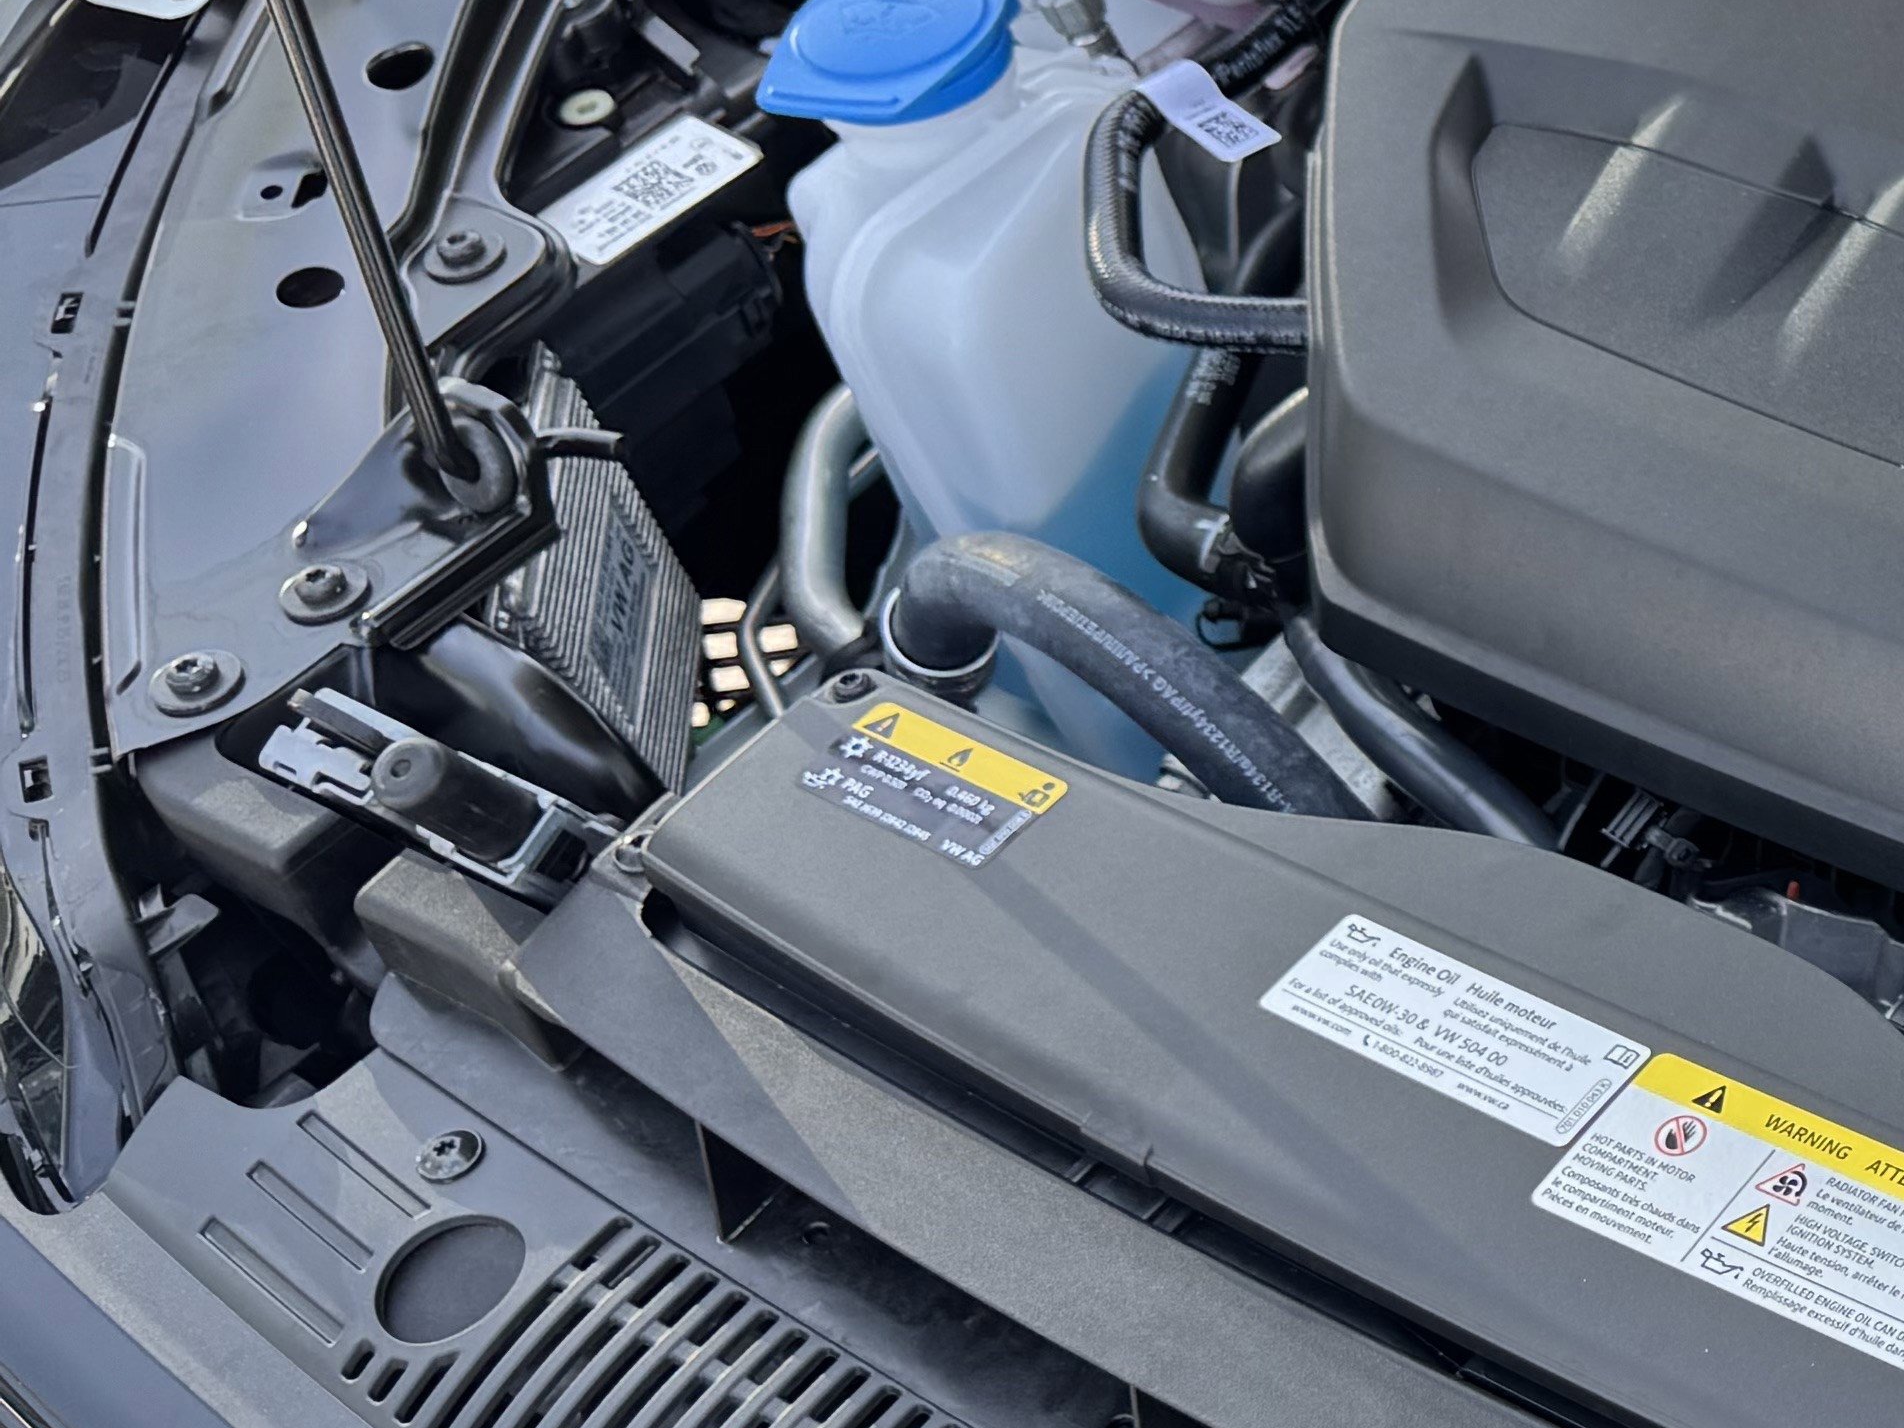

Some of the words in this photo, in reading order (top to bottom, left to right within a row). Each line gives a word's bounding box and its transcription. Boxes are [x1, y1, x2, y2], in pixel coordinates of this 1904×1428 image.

[1388, 946, 1436, 975] Engine
[1436, 969, 1461, 985] Oil
[1466, 982, 1504, 1006] Huile
[1503, 1002, 1557, 1029] moteur
[1415, 1018, 1430, 1030] &
[1434, 1024, 1462, 1043] VW
[1457, 1037, 1488, 1057] 504
[1486, 1051, 1508, 1066] 00
[1590, 1133, 1615, 1146] HOT
[1612, 1141, 1646, 1161] PARTS
[1644, 1156, 1658, 1166] IN
[1657, 1161, 1696, 1183] MOTOR
[1764, 1113, 1853, 1160] WARNING
[1572, 1152, 1616, 1176] MOVING
[1551, 1176, 1562, 1187] le
[1562, 1183, 1635, 1220] compartiment
[1561, 1165, 1621, 1198] Composants
[1640, 1202, 1676, 1223] chauds
[1675, 1217, 1701, 1234] dans
[1574, 1204, 1589, 1215] en
[1806, 1200, 1853, 1226] moment.
[1815, 1188, 1830, 1200] Le
[1830, 1196, 1887, 1224] ventilateur
[1886, 1220, 1902, 1231] de
[1826, 1177, 1879, 1204] RADIATOR
[1877, 1198, 1901, 1214] FAN
[1786, 1224, 1835, 1250] IGNITION
[1794, 1214, 1823, 1231] HIGH
[1776, 1236, 1809, 1257] Haute
[1851, 1271, 1889, 1291] arrêter
[1888, 1285, 1900, 1297] le
[1742, 1277, 1807, 1313] Remplissage
[1752, 1267, 1815, 1300] OVERFILLED
[1813, 1294, 1856, 1318] ENGINE
[1854, 1312, 1872, 1327] OIL
[1873, 1320, 1897, 1337] CAN
